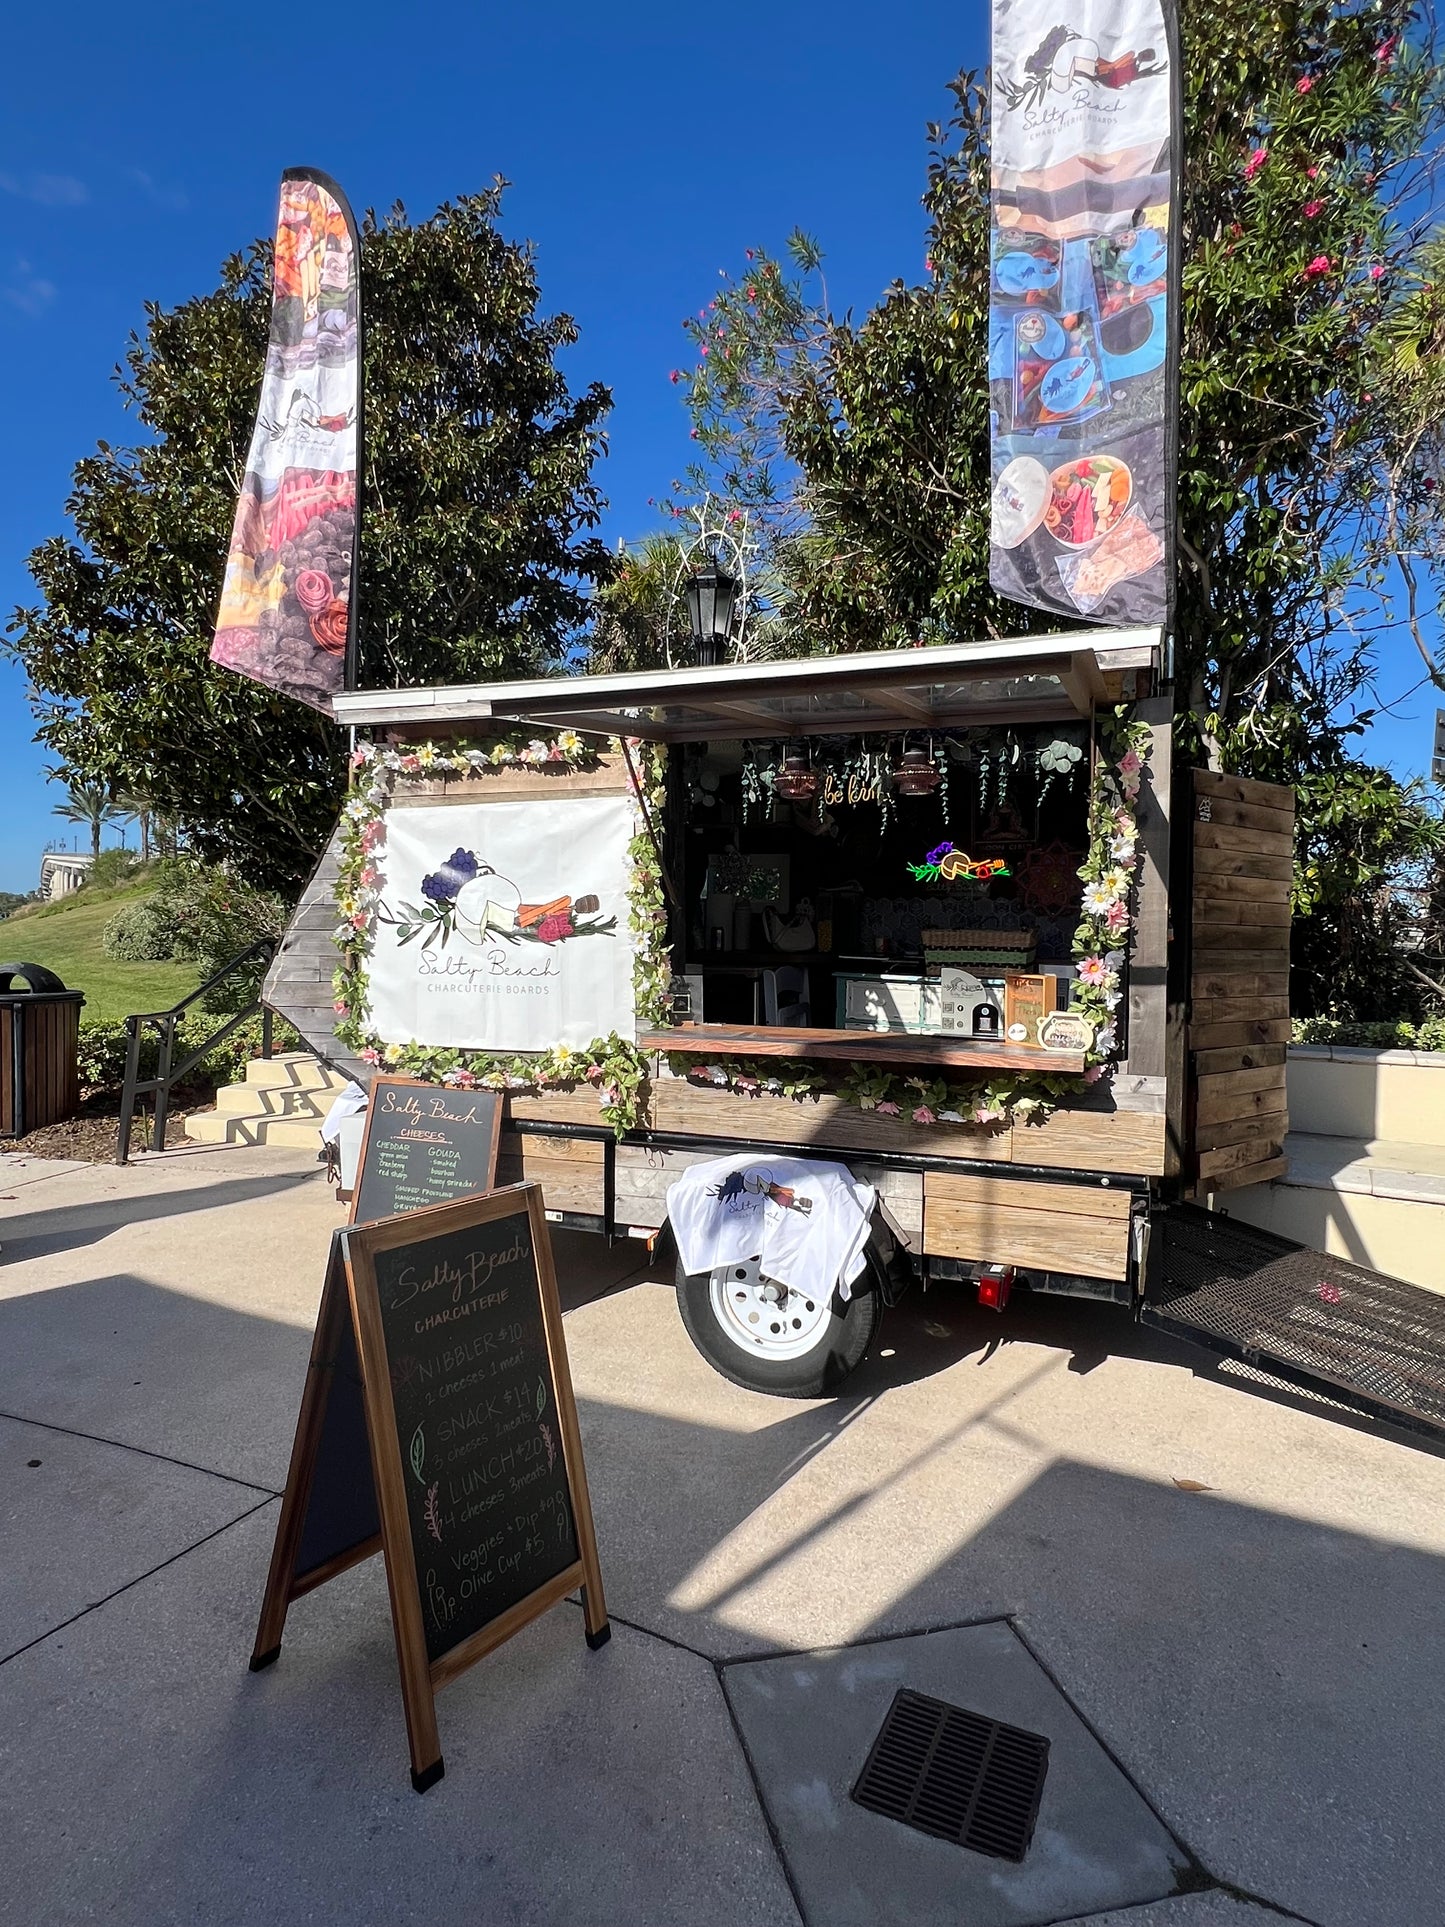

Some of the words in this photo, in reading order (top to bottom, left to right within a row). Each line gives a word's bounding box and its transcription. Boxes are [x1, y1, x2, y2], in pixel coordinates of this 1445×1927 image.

[1022, 106, 1070, 131] Salty
[1072, 88, 1127, 112] Beach
[824, 775, 844, 805] be
[418, 950, 484, 983] Salty
[487, 949, 560, 977] Beach
[427, 983, 502, 994] CHARCUTERIE
[506, 985, 550, 995] BOARDS
[381, 1091, 426, 1125] Salty
[428, 1097, 484, 1124] Beach
[376, 1140, 411, 1152] CHEDDAR
[400, 1128, 446, 1141] CHEESES
[427, 1147, 461, 1160] GOUDA
[728, 1200, 760, 1213] Salty
[390, 1260, 464, 1310] Salty
[465, 1235, 530, 1294] Beach
[414, 1288, 509, 1334] CHARCUTERIE
[418, 1331, 498, 1383] NIBBLER
[499, 1322, 523, 1344] $10
[425, 1392, 434, 1406] 2
[438, 1369, 486, 1397] cheeses
[437, 1395, 503, 1442] SNACK
[503, 1381, 531, 1409] $14
[432, 1454, 443, 1471] 3
[447, 1433, 489, 1462] cheeses
[449, 1450, 516, 1504] LUNCH
[517, 1437, 543, 1462] $20
[442, 1511, 456, 1528] 4
[460, 1489, 505, 1523] cheeses
[451, 1531, 504, 1571] Veggies
[515, 1512, 539, 1532] Dip
[460, 1570, 495, 1599] Olive
[497, 1551, 522, 1573] Cup
[525, 1532, 545, 1557] $5
